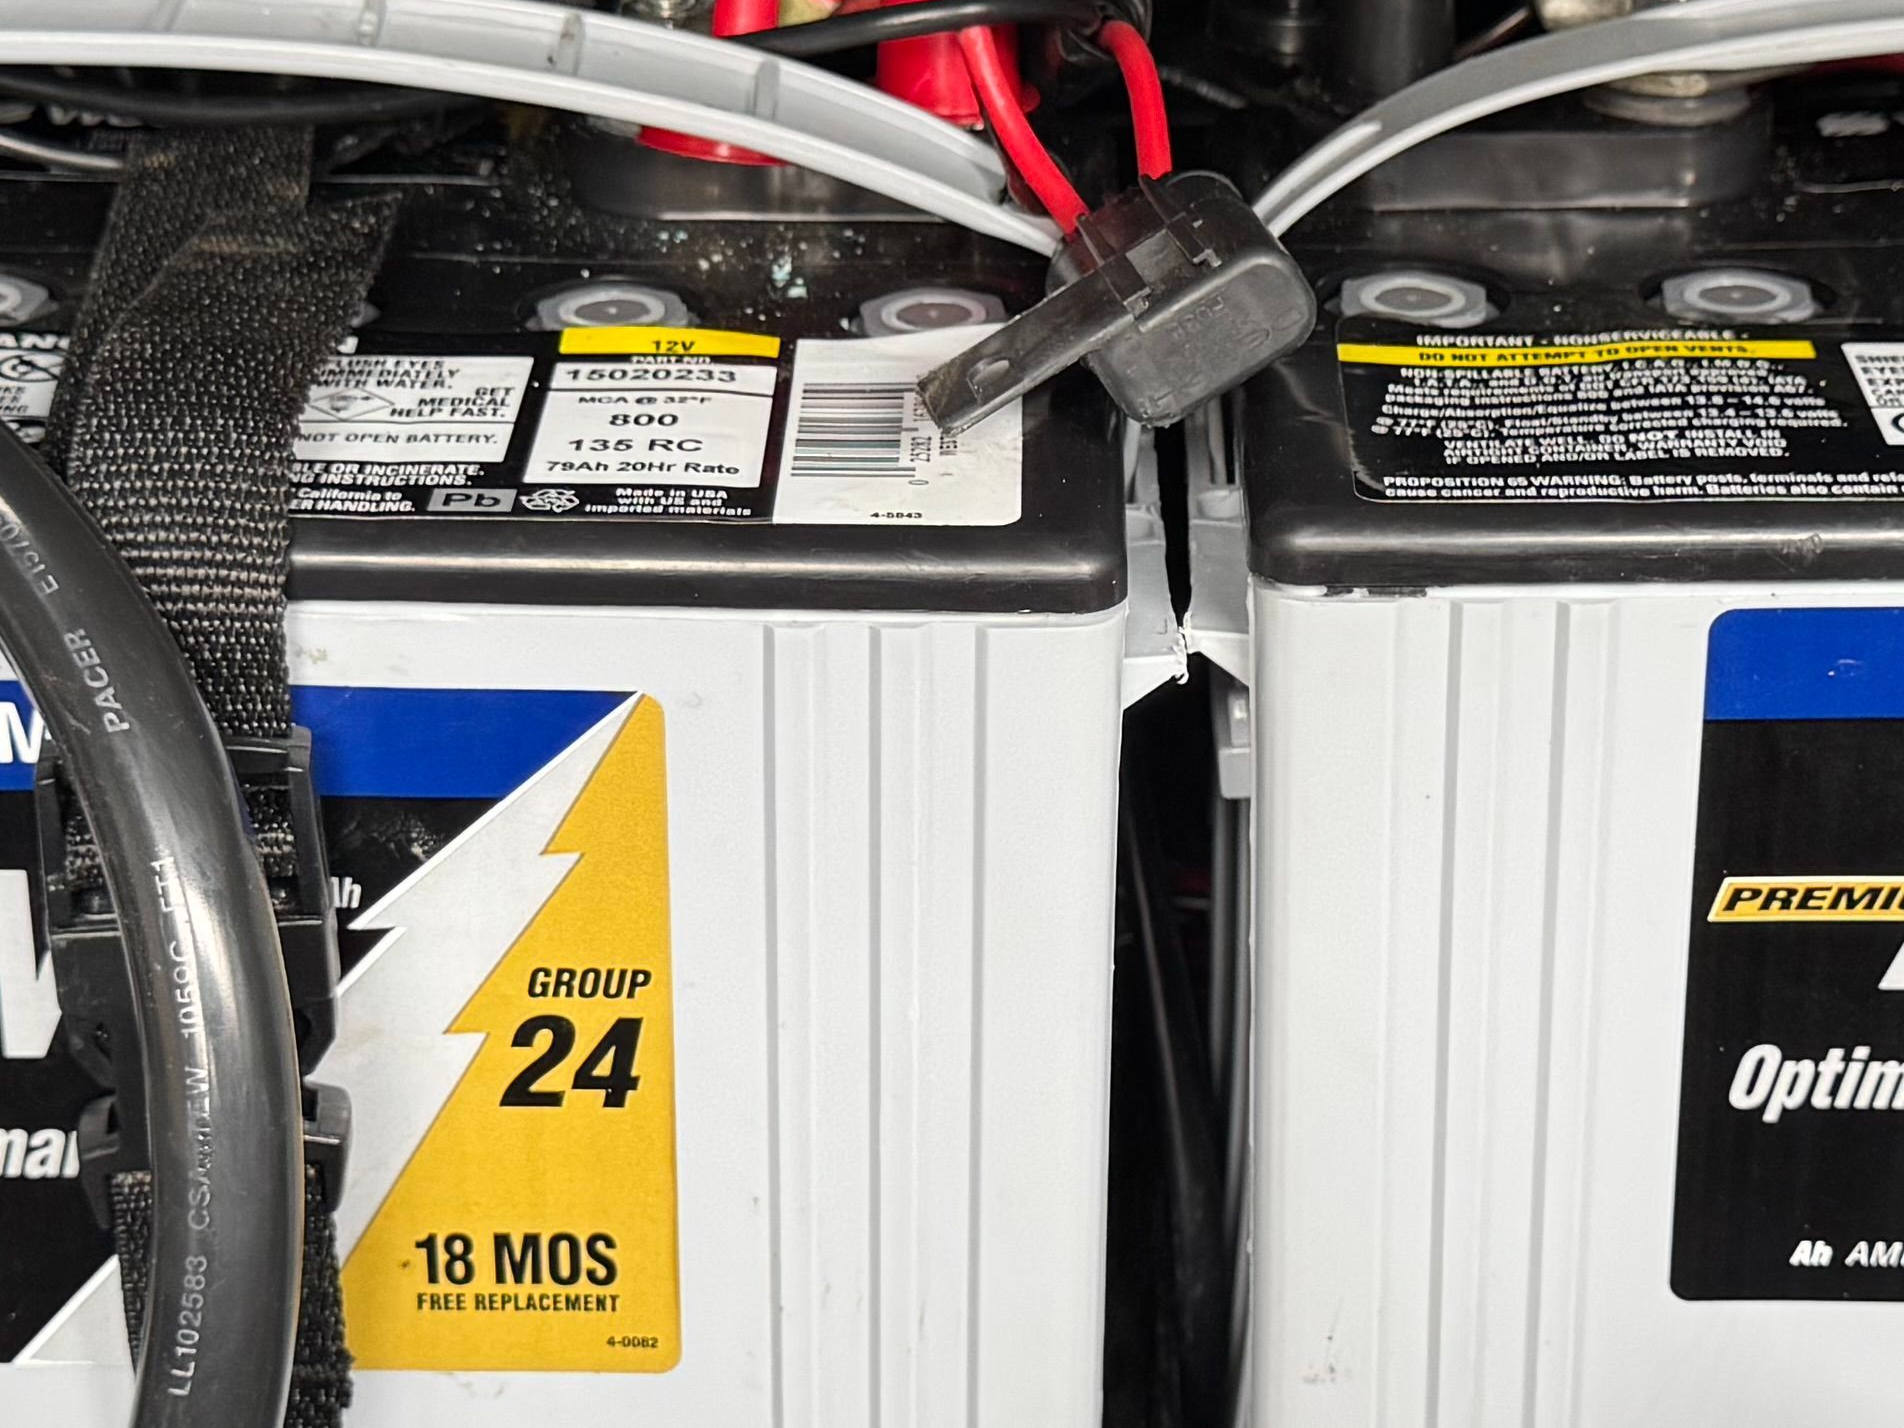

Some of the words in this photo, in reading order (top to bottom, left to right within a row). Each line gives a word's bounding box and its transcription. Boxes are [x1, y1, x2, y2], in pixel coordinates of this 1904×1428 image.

[652, 340, 696, 352] 12V
[1416, 334, 1534, 347] IMPORTANT
[1419, 352, 1444, 361] DO
[1451, 352, 1489, 362] NOT
[1496, 350, 1587, 362] ATTEMPT
[1626, 345, 1680, 354] OPEN
[566, 369, 737, 382] 15020233
[475, 387, 515, 397] GET
[418, 397, 511, 407] MEDICAL
[579, 395, 628, 404] MCA
[389, 408, 443, 418] HELP
[450, 408, 505, 418] FAST.
[609, 413, 679, 427] 800
[345, 433, 399, 443] OPEN
[405, 433, 498, 444] BATTERY.
[568, 438, 633, 452] 135
[648, 438, 704, 452] RC
[330, 463, 360, 474] OR
[364, 463, 485, 476] INCINERATE.
[546, 460, 609, 472] 79Ah
[619, 461, 677, 473] 20Hr
[684, 462, 740, 475] Rate
[318, 473, 473, 486] INSTRUCTIONS.
[1383, 476, 1504, 487] PROPOSITION
[1629, 474, 1693, 487] Battery
[298, 487, 382, 501] California
[441, 492, 502, 508] Pb
[316, 499, 416, 512] HANDLING.
[62, 628, 130, 734] PACER
[526, 967, 653, 1000] GROUP
[498, 1013, 644, 1110] 24
[414, 1232, 476, 1285] 18
[492, 1234, 618, 1287] MOS
[1789, 1240, 1834, 1269] Ah
[416, 1292, 466, 1311] FREE
[474, 1292, 620, 1313] REPLACEMENT
[168, 1254, 209, 1397] LL102583
